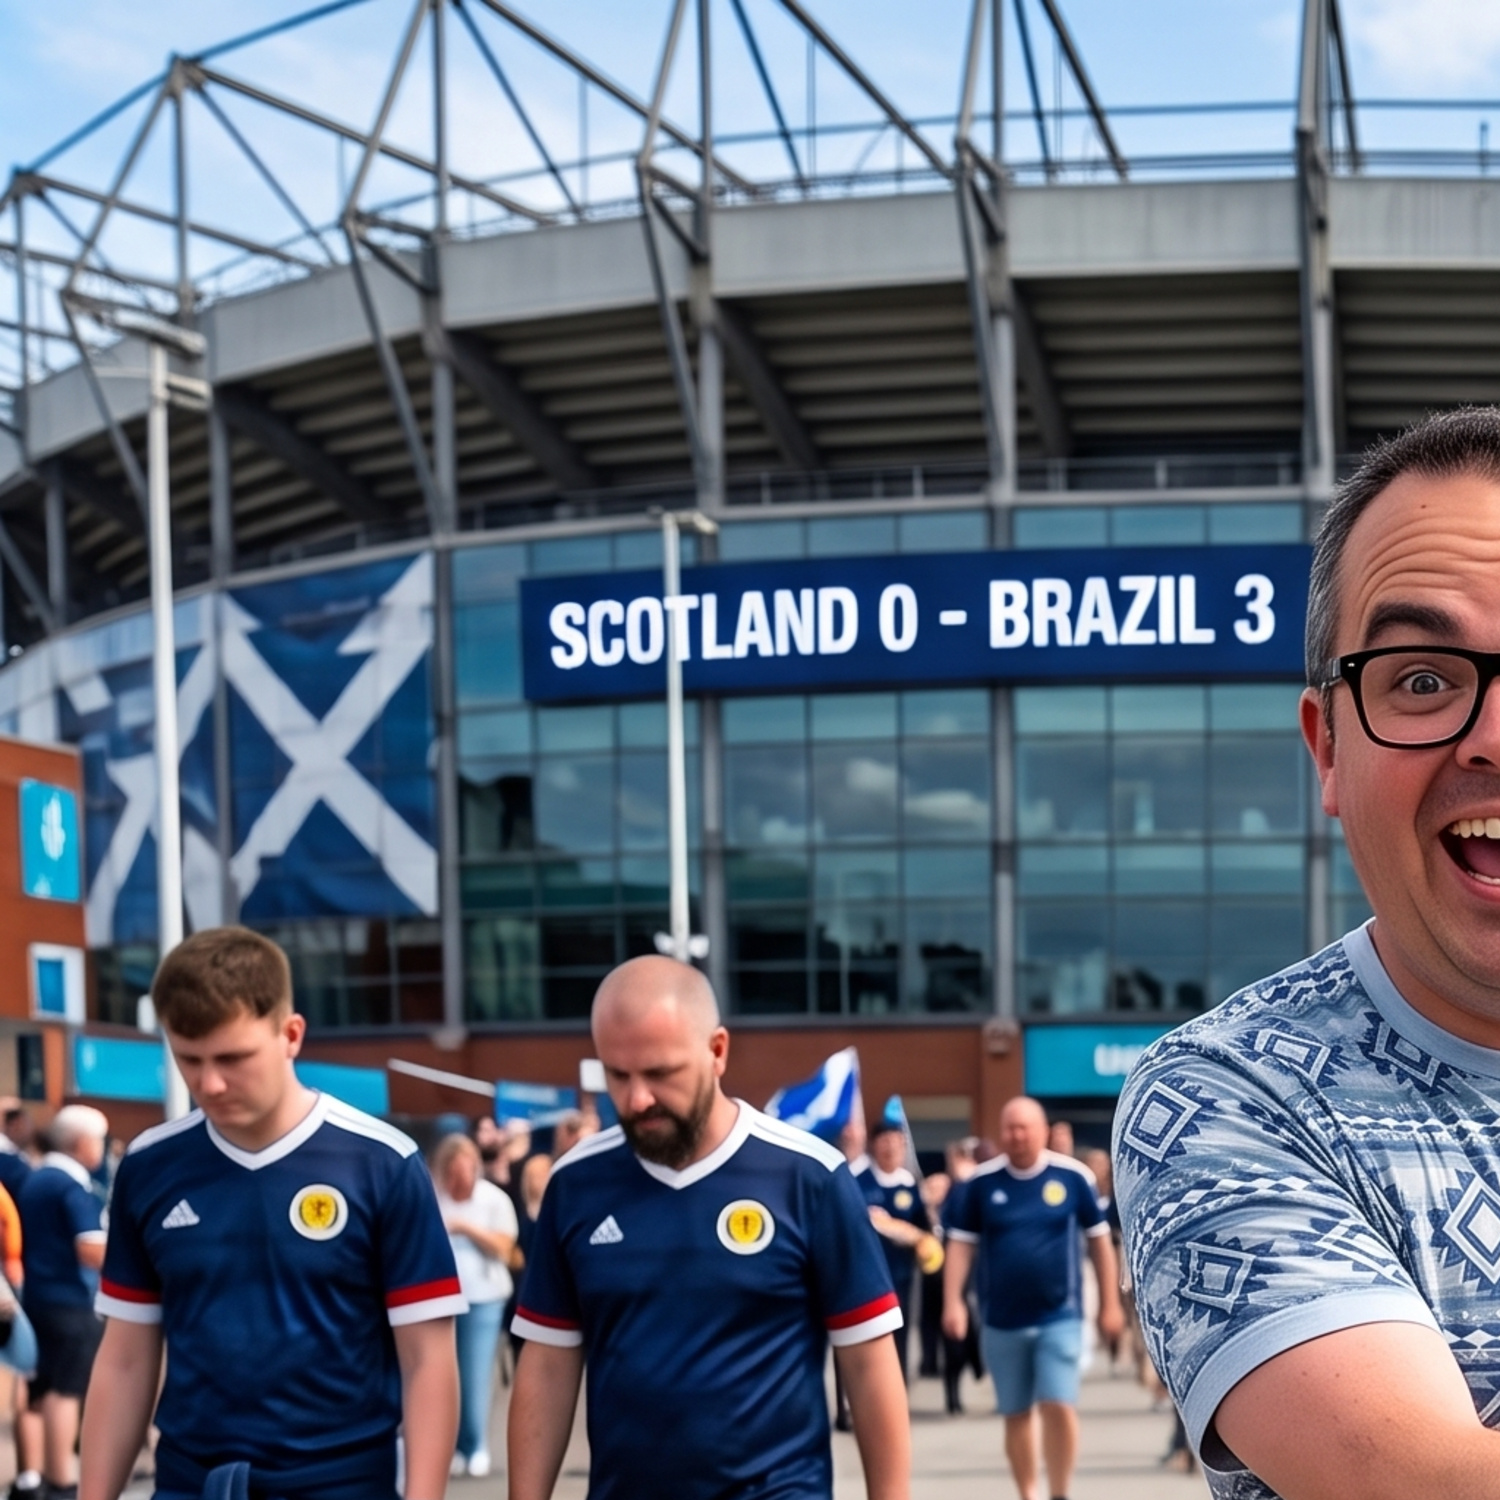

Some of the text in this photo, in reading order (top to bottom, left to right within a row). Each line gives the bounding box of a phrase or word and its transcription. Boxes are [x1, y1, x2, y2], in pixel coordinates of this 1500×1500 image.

[548, 572, 1277, 671] SCOTLAND 0 - BRAZIL 3
